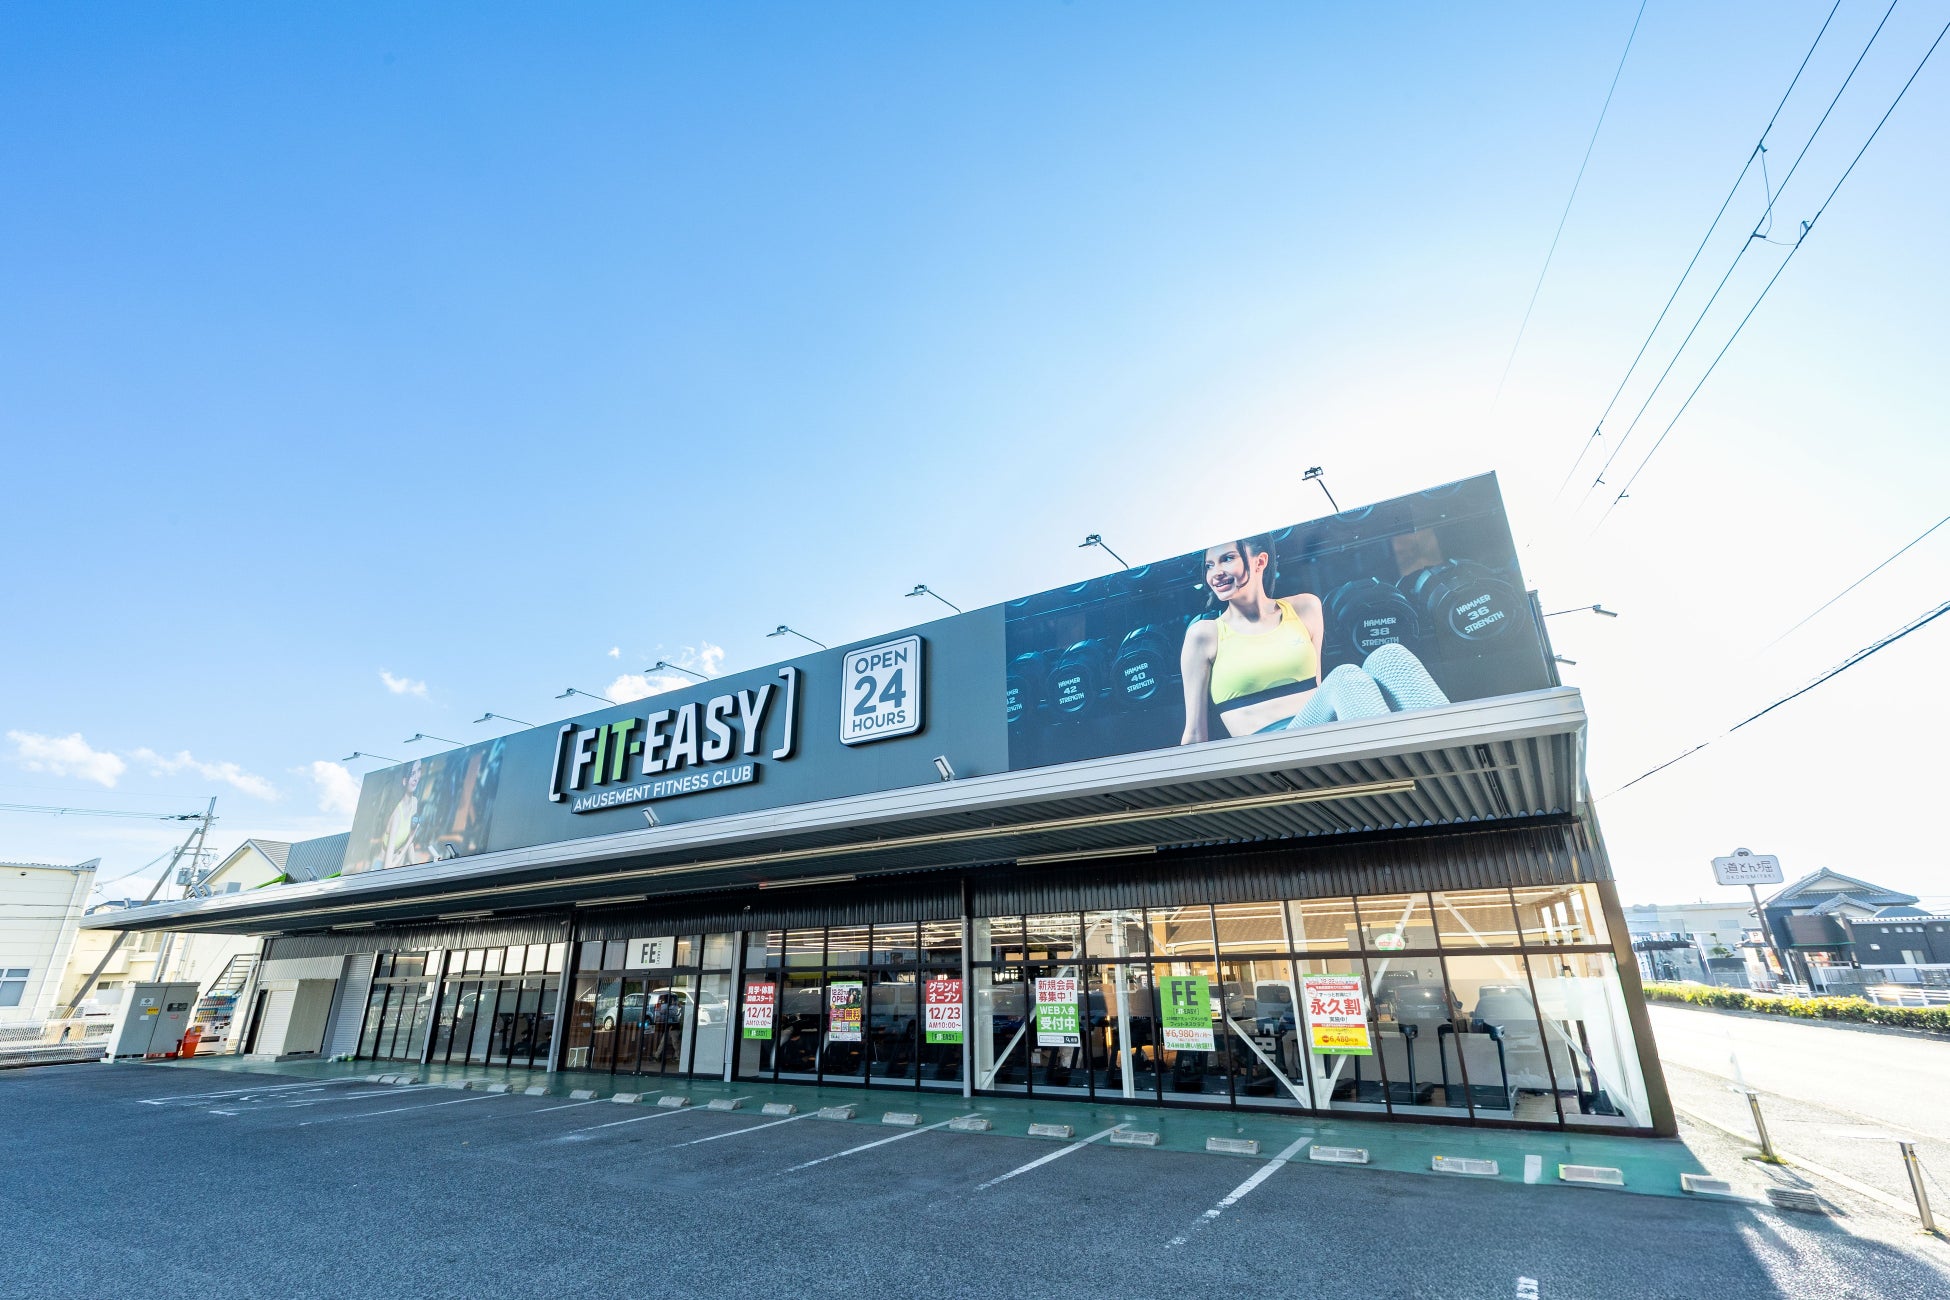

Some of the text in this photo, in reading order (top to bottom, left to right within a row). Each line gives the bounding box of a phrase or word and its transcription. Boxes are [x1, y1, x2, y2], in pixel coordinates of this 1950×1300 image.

[1455, 594, 1491, 615] HAMMER
[1467, 606, 1490, 620] 36
[1363, 617, 1397, 628] HAMMER
[1464, 611, 1505, 634] STRENGTH
[1369, 627, 1390, 637] 38
[855, 647, 908, 674] OPEN
[1124, 662, 1149, 676] HAMMER
[1058, 676, 1081, 689] HAMMER
[1130, 672, 1146, 682] 40
[854, 668, 907, 716] 24
[1063, 685, 1078, 694] 42
[1126, 678, 1155, 693] STRENGTH
[1059, 692, 1085, 705] STRENGTH
[853, 710, 906, 732] HOURS
[574, 765, 752, 812] AMUSEMENT FITNESS CLUB
[1723, 861, 1774, 873] 道とん堀
[929, 981, 960, 992] グランド
[1038, 980, 1075, 990] 新規会員
[929, 992, 960, 1003] オープン
[1039, 991, 1073, 1002] 募集中!
[747, 1006, 772, 1018] 12/12
[929, 1006, 961, 1020] 12/23
[1040, 1006, 1076, 1015] WEB入会
[1311, 998, 1361, 1015] 永久割
[1040, 1016, 1076, 1031] 受付中
